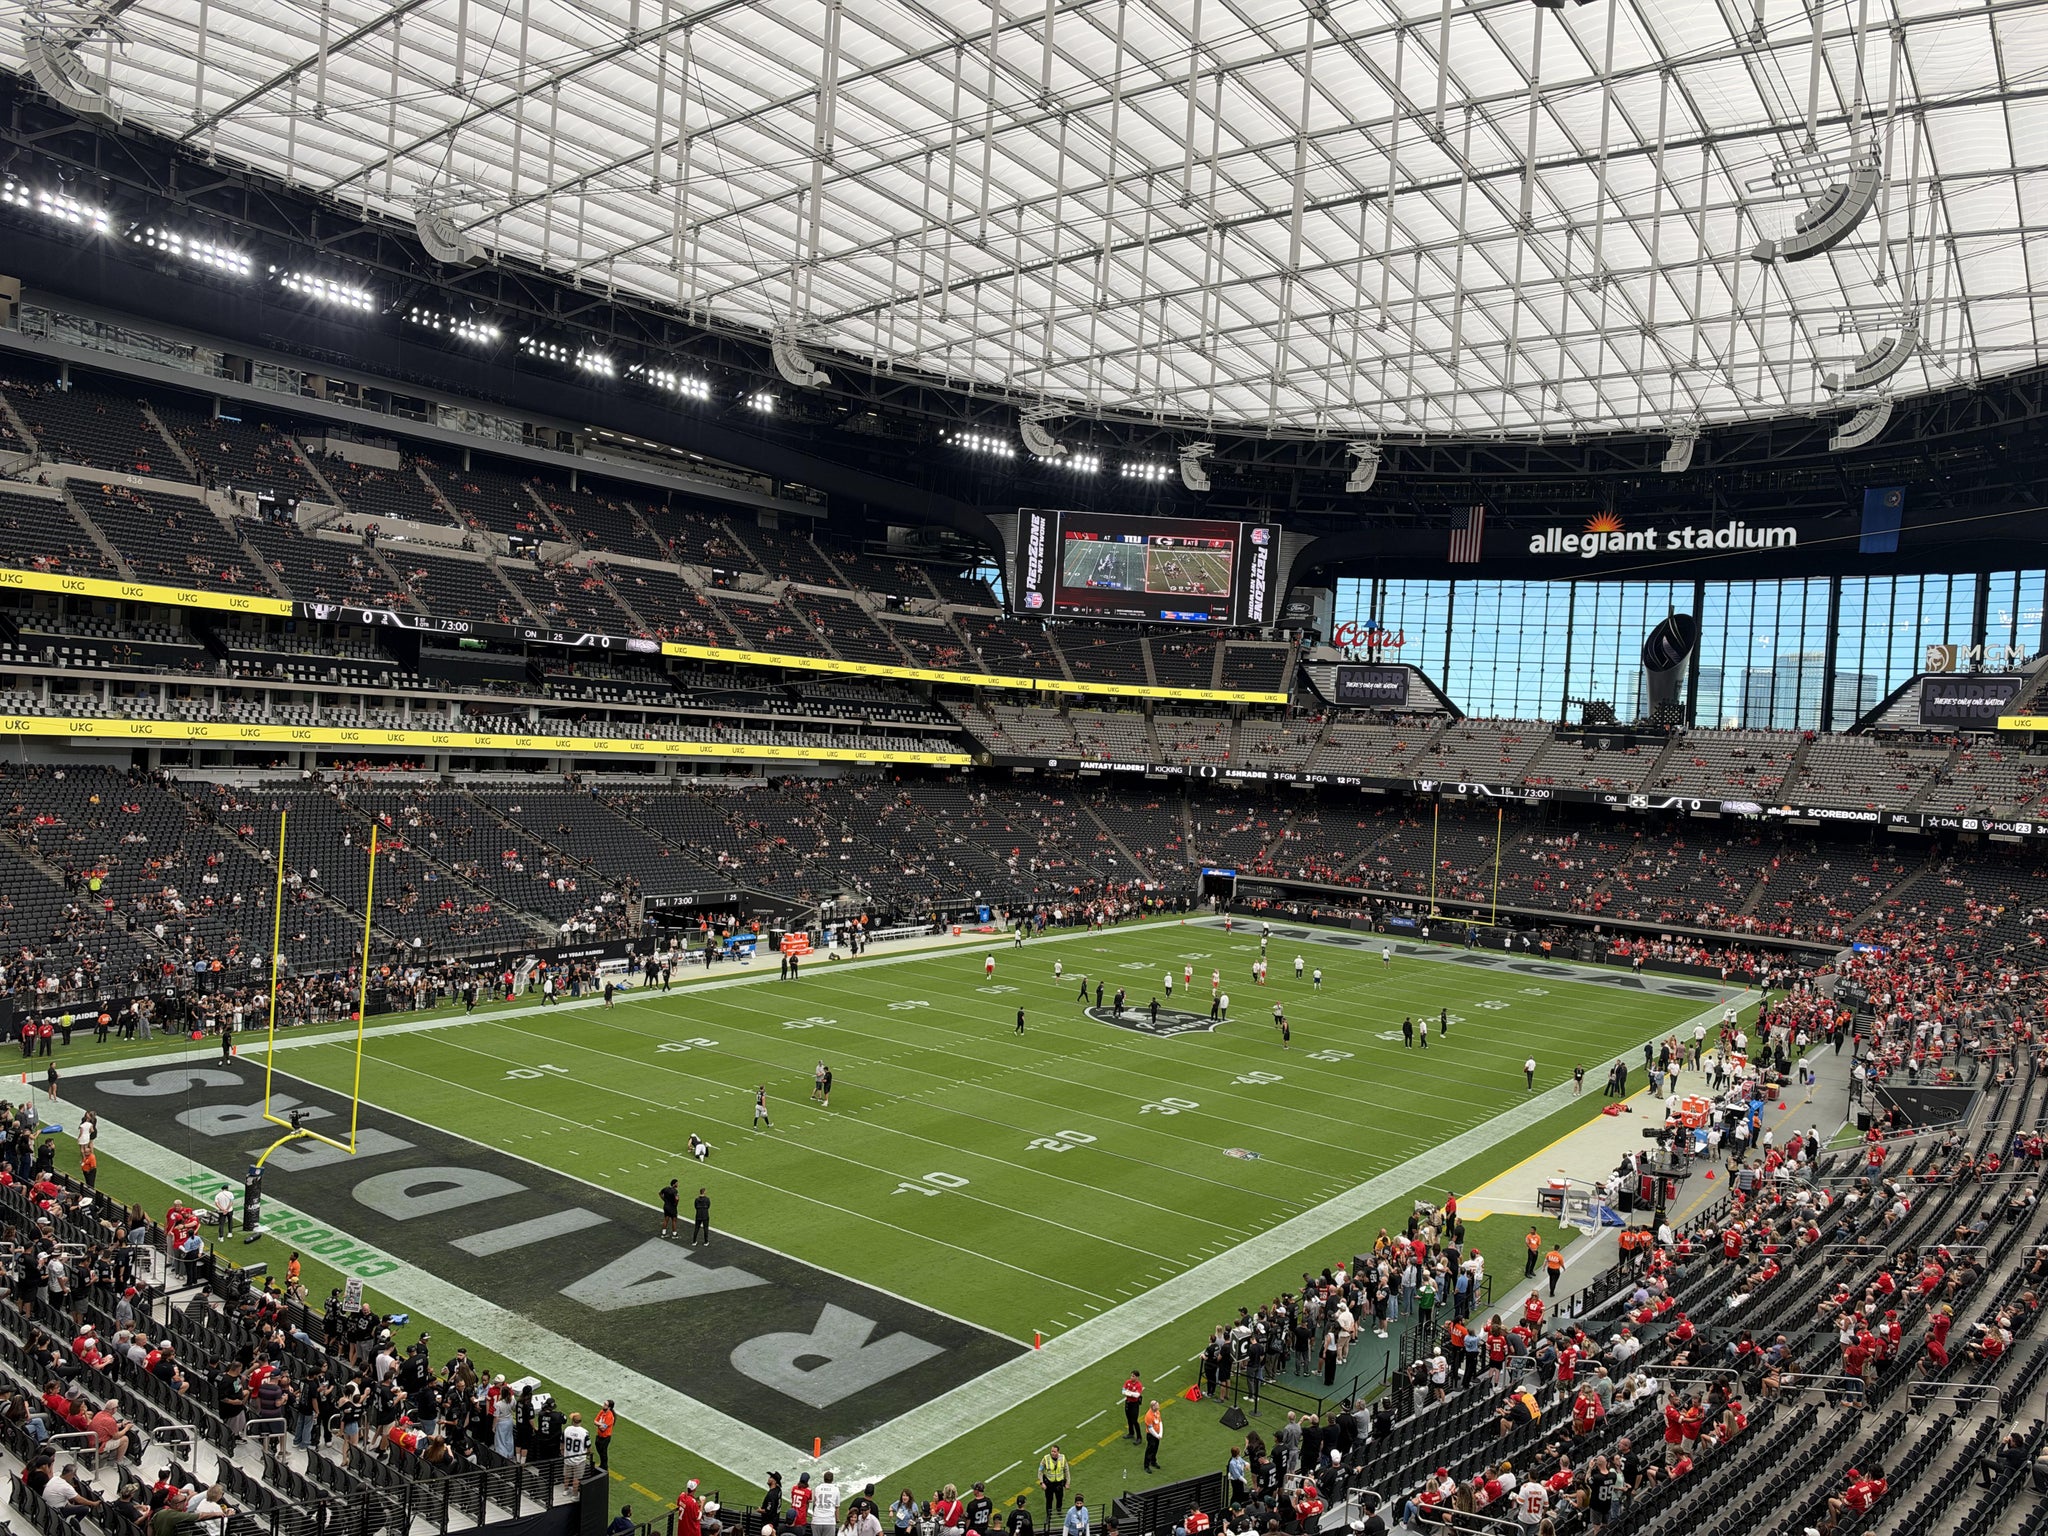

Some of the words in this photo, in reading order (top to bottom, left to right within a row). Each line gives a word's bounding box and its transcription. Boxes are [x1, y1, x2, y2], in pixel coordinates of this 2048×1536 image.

[126, 476, 143, 485] 436
[1528, 527, 1658, 558] allegiant
[1666, 520, 1797, 550] stadium
[0, 573, 23, 585] UKG
[62, 580, 85, 591] UKG
[122, 587, 143, 598] UKG
[178, 593, 197, 603] UKG
[230, 599, 249, 609] UKG
[362, 611, 372, 624] 0
[441, 619, 468, 632] 73:00
[525, 630, 537, 638] ON
[553, 633, 563, 641] 25
[1334, 621, 1407, 648] Coors
[602, 637, 610, 648] 0
[1341, 648, 1399, 663] LIGHT
[1961, 644, 2025, 661] MGM
[1960, 663, 2024, 673] REWARDS
[1340, 671, 1405, 686] RAIDER
[1339, 685, 1403, 699] NATION
[1926, 684, 2014, 700] RAIDER
[2014, 720, 2031, 728] UKG
[5, 720, 30, 732] UKG
[70, 723, 93, 733] UKG
[131, 725, 152, 735] UKG
[187, 727, 207, 736] UKG
[241, 729, 260, 738] UKG
[292, 730, 311, 739] UKG
[341, 732, 359, 741] UKG
[388, 734, 404, 742] UKG
[432, 736, 448, 744] UKG
[516, 739, 531, 747] UKG
[594, 742, 608, 750] UKG
[1080, 762, 1113, 770] FANTASY
[1113, 763, 1145, 772] LEADERS
[1155, 765, 1183, 774] KICKING
[1225, 770, 1267, 779] S.SHRADER
[1280, 772, 1297, 780] FGM
[1312, 775, 1328, 783] FGA
[1337, 776, 1345, 784] 12
[1346, 777, 1361, 785] PTS
[1457, 784, 1466, 794] 0
[1524, 788, 1550, 798] 73:00
[1631, 796, 1646, 807] 25
[1691, 799, 1700, 810] 0
[1767, 806, 1800, 817] allegiant
[1807, 808, 1877, 822] SCOREBOARD
[1892, 815, 1910, 824] NFL
[1941, 818, 1959, 828] DAL
[1964, 820, 1976, 829] 20
[1994, 822, 2015, 832] HOU
[2017, 824, 2029, 833] 23
[674, 896, 693, 905] 73:00
[585, 949, 605, 957] RAIDERS
[1212, 920, 1373, 946] LAS
[1393, 943, 1721, 998] VEGAS
[656, 1037, 720, 1052] 20
[1307, 1049, 1355, 1062] 50
[505, 1064, 569, 1079] 10
[1234, 1071, 1284, 1086] 40
[1141, 1097, 1201, 1116] 30
[1686, 1117, 1693, 1125] G
[1030, 1129, 1098, 1153] 20
[898, 1171, 972, 1197] 10
[94, 1068, 947, 1409] RAIDERS
[179, 1231, 187, 1240] 15
[258, 1210, 399, 1278] CHOOSE
[1726, 1238, 1735, 1248] 15
[1240, 1341, 1248, 1353] C
[1493, 1343, 1501, 1352] 15
[417, 1365, 424, 1378] 2
[1586, 1406, 1595, 1418] 15
[566, 1437, 581, 1453] 88
[1268, 1476, 1277, 1488] 15
[792, 1495, 802, 1508] 15
[820, 1493, 834, 1509] 15
[1527, 1496, 1542, 1514] 15
[1864, 1492, 1872, 1509] 15
[975, 1509, 990, 1525] 98
